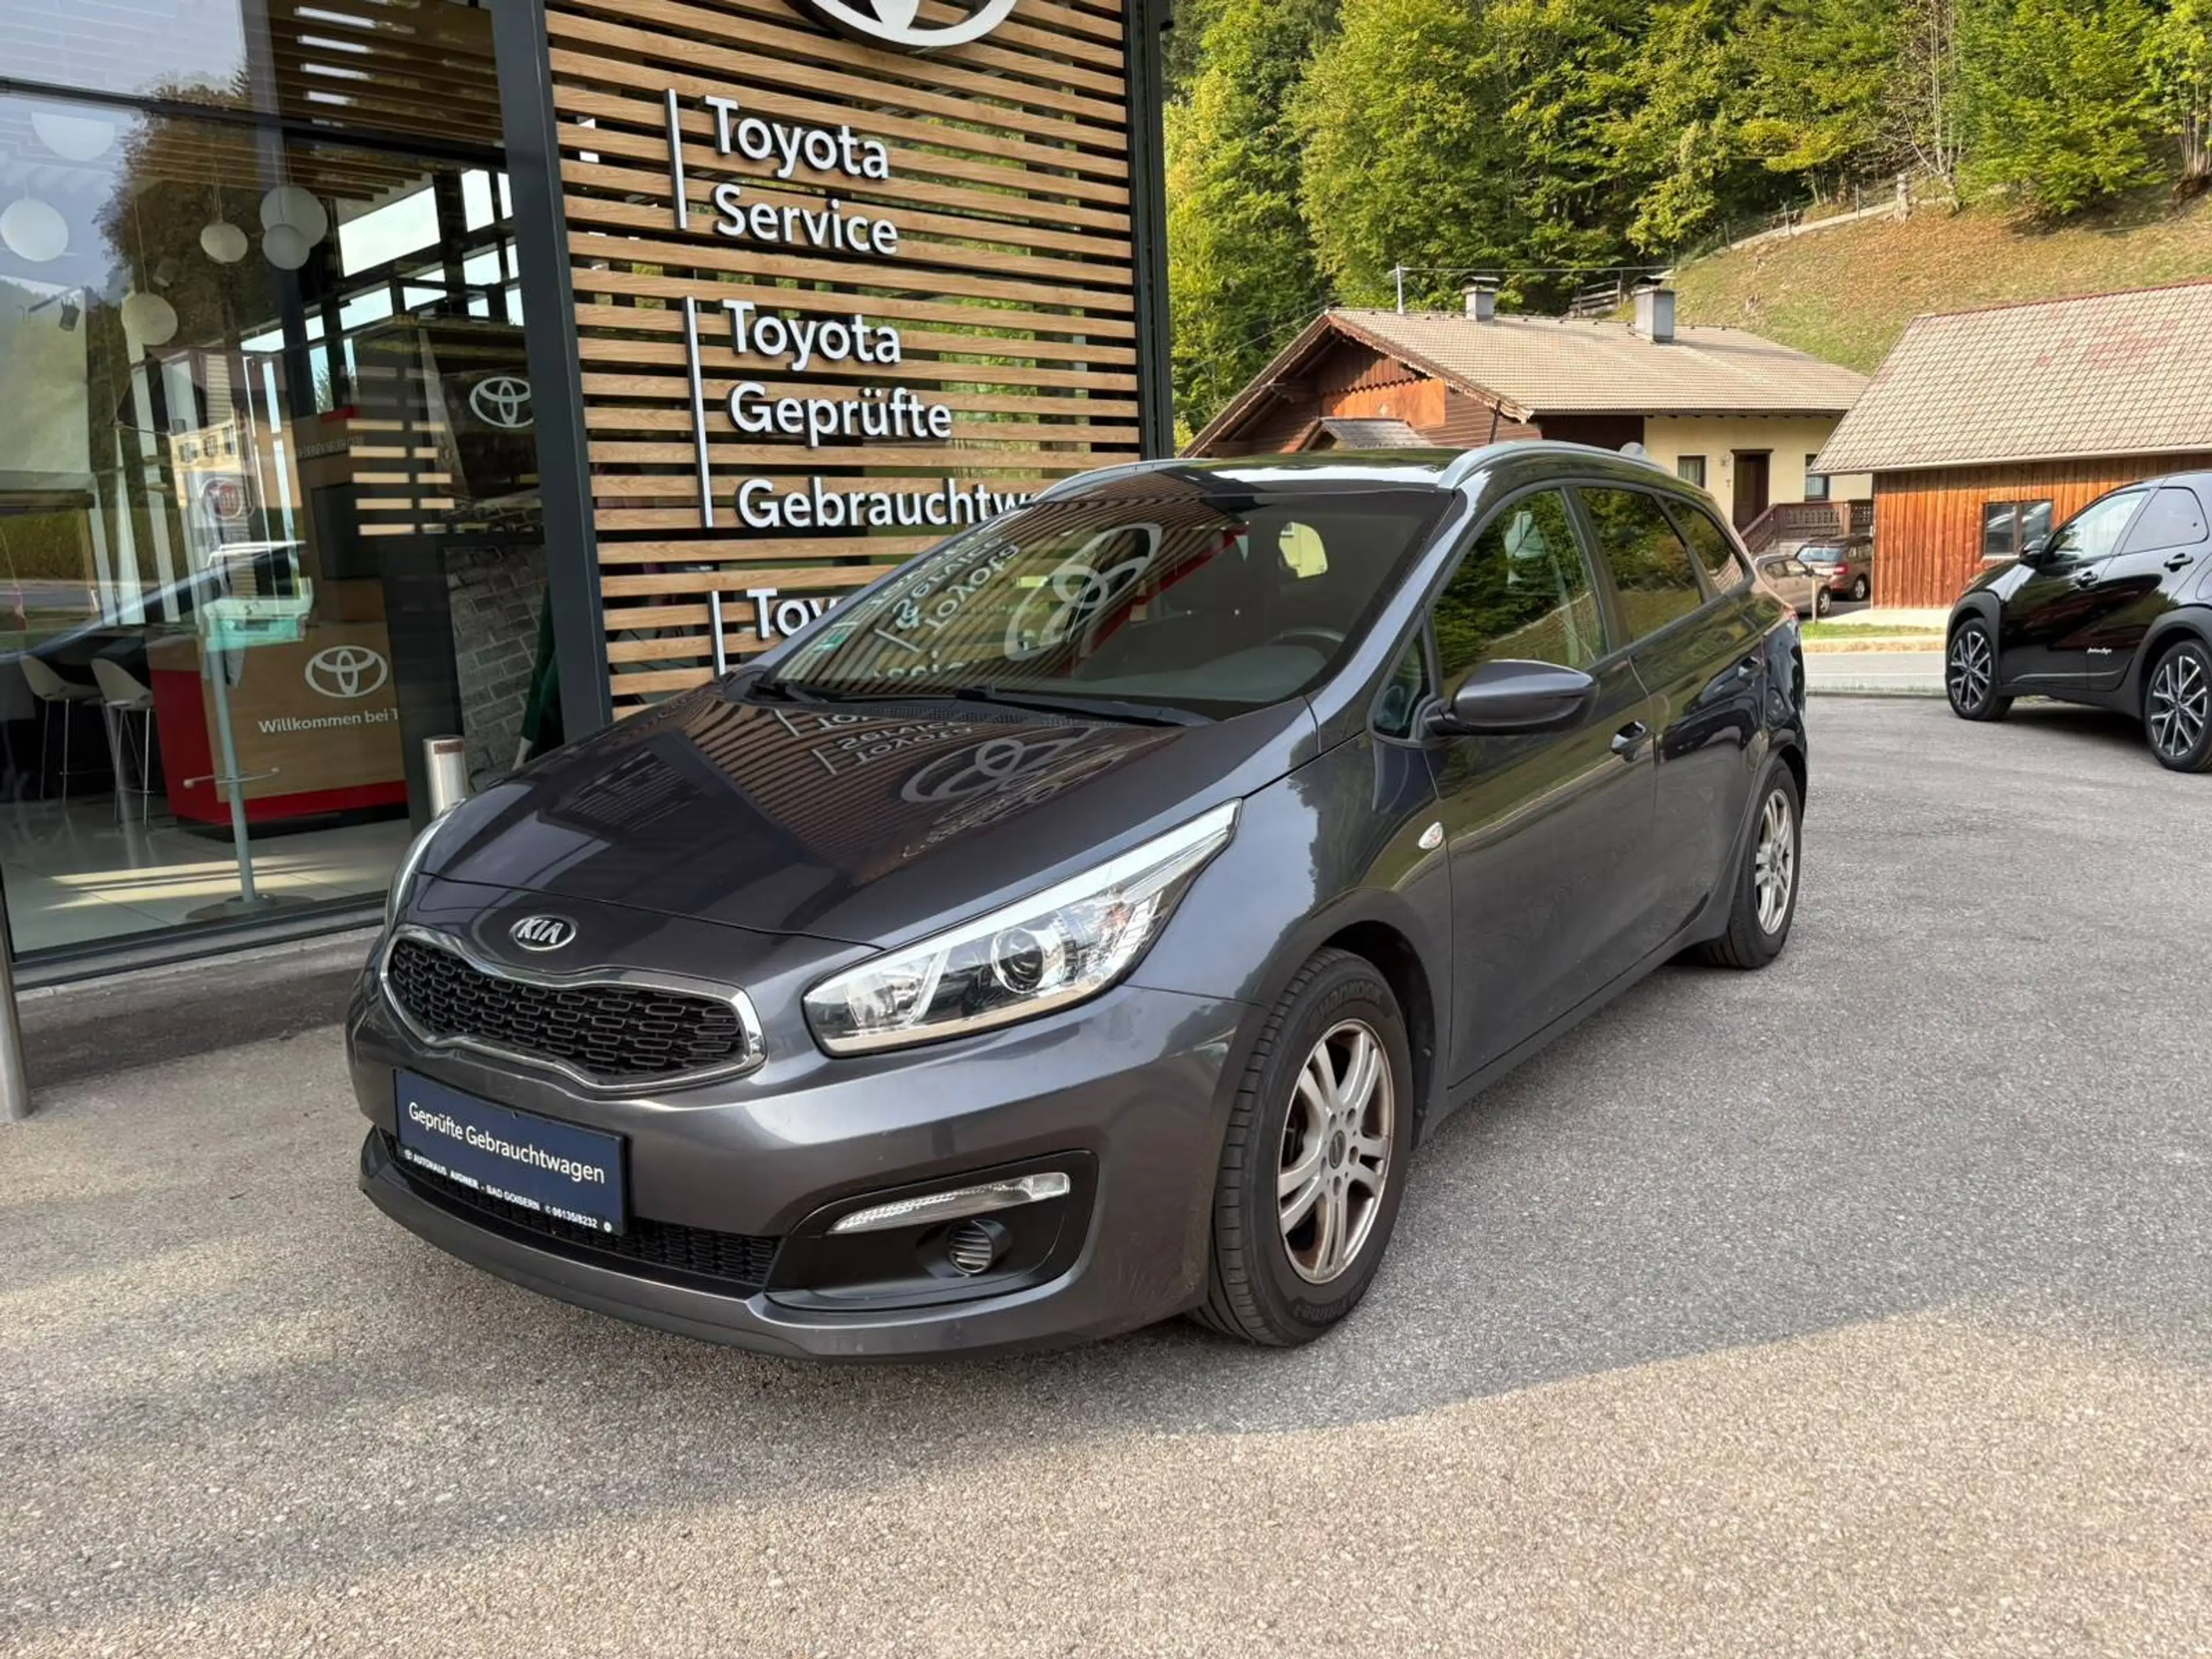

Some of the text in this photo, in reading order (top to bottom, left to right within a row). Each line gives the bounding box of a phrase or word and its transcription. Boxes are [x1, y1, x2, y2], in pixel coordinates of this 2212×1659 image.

[703, 95, 889, 179] Toyota
[713, 183, 899, 255] Service
[721, 298, 902, 372] Toyota
[729, 381, 952, 448] Geprüfte
[258, 714, 361, 733] Willkommen
[364, 708, 389, 723] bei
[517, 918, 564, 944] KIA
[408, 1101, 605, 1184] Geprüfte Gebrauchtwagen
[412, 1153, 448, 1176] AUTOHAUS
[486, 1184, 503, 1199] BAD
[503, 1191, 540, 1211] GOISERN
